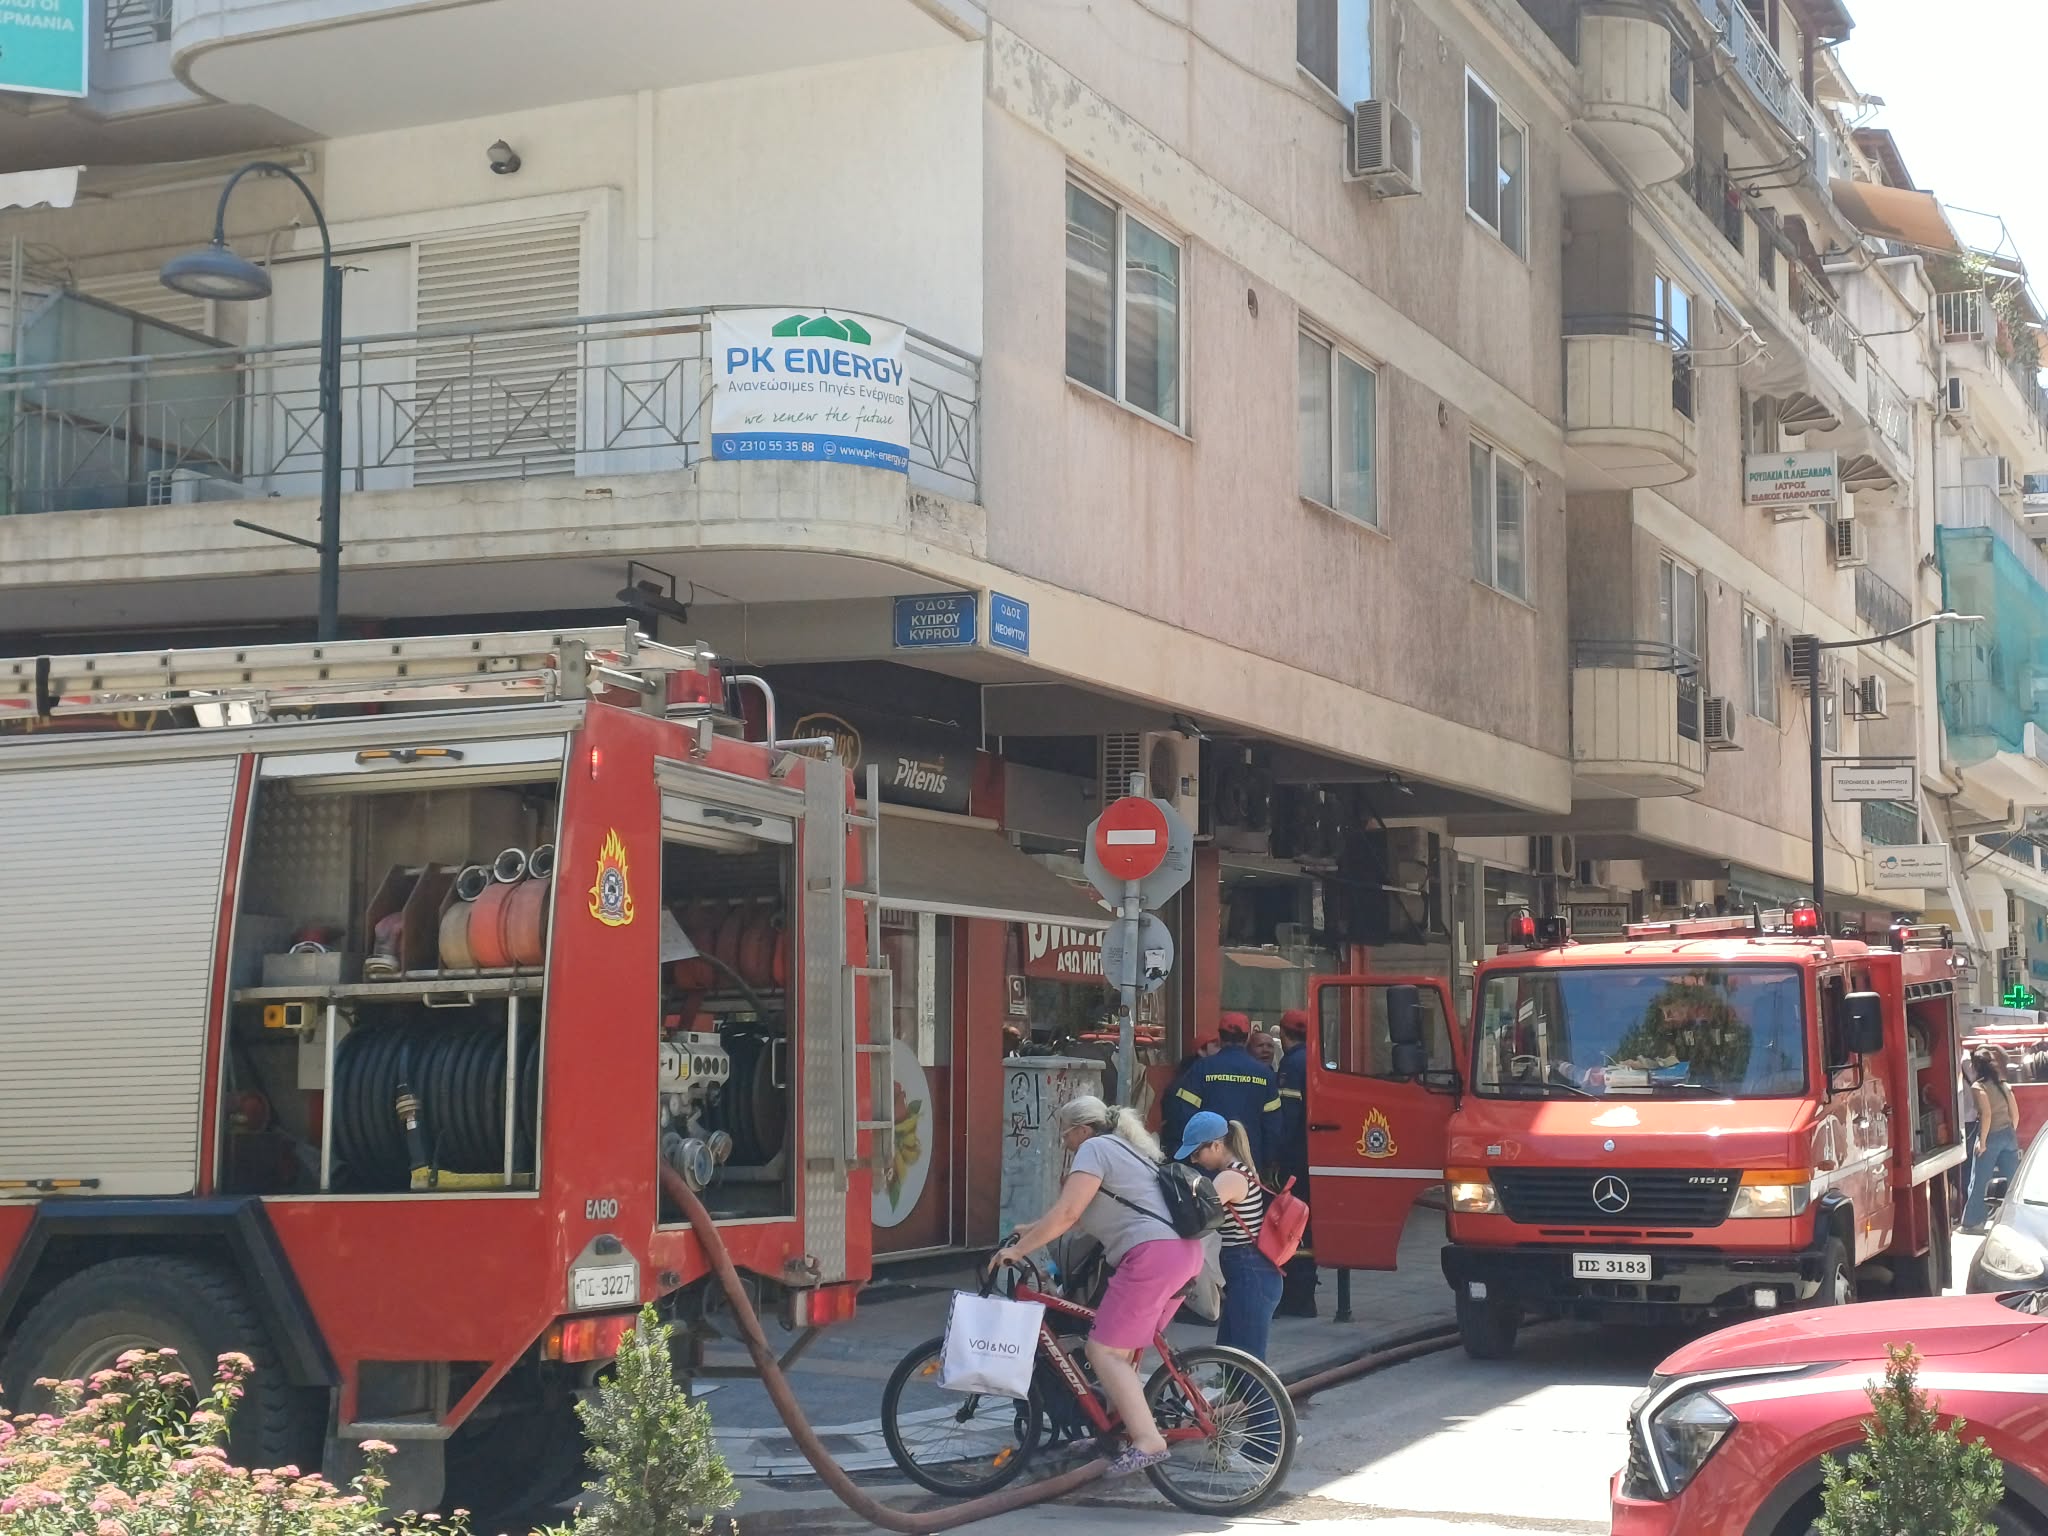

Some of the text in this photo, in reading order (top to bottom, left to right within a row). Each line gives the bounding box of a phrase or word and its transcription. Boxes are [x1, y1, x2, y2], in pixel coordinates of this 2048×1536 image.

[727, 346, 903, 386] PK ENERGY
[728, 378, 905, 406] Ανανεώσιμες Πηγές Ενέργειας
[744, 405, 894, 432] we renew the future
[739, 439, 766, 451] 2310
[769, 440, 783, 451] 55
[785, 440, 799, 452] 35
[801, 441, 815, 452] 88
[1775, 481, 1806, 491] ΙΑΤΡΟΣ
[1782, 489, 1831, 500] ΠΑΘΟΛΟΓΟΣ
[915, 600, 956, 611] ΟΔΟΣ
[1001, 604, 1021, 620] ΟΔΟΣ
[911, 613, 960, 626] ΚΥΠΡΟΥ
[909, 628, 960, 641] KYPROU
[995, 622, 1026, 642] ΝΕΟΦΥΤΟΥ
[894, 757, 948, 794] Pitenis
[1205, 1074, 1267, 1086] ΠΥΡΟΣΒΕΣΤΙΚΟ ΣΩΜΑ
[586, 1200, 618, 1219] ΕΛΒΟ
[1578, 1260, 1646, 1274] ΠΣ 3183
